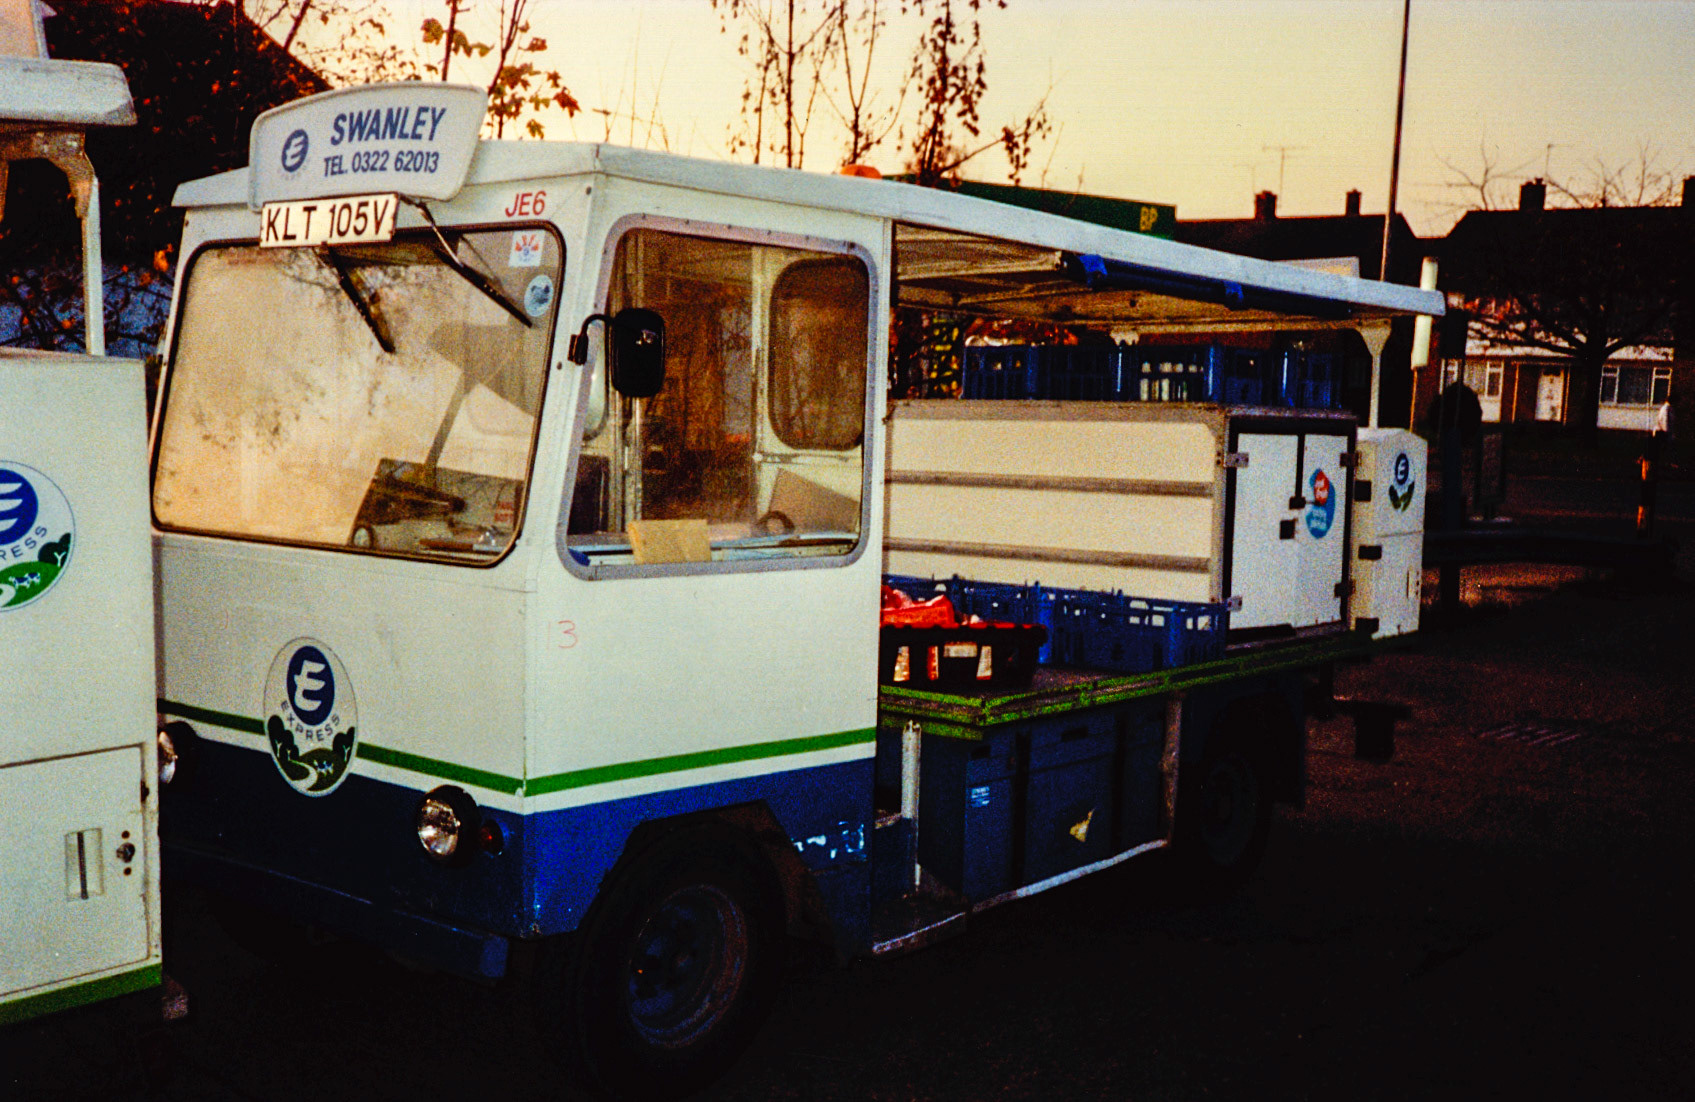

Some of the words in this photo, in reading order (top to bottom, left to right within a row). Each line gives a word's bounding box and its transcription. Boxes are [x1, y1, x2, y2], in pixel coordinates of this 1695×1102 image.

[330, 106, 446, 145] SWANLEY
[324, 154, 349, 177] TEL.
[352, 151, 388, 173] 0322
[394, 151, 440, 174] 62013
[265, 205, 317, 242] KLT
[329, 199, 391, 239] 105V
[505, 190, 547, 217] JE6
[280, 700, 340, 742] EXPRESS
